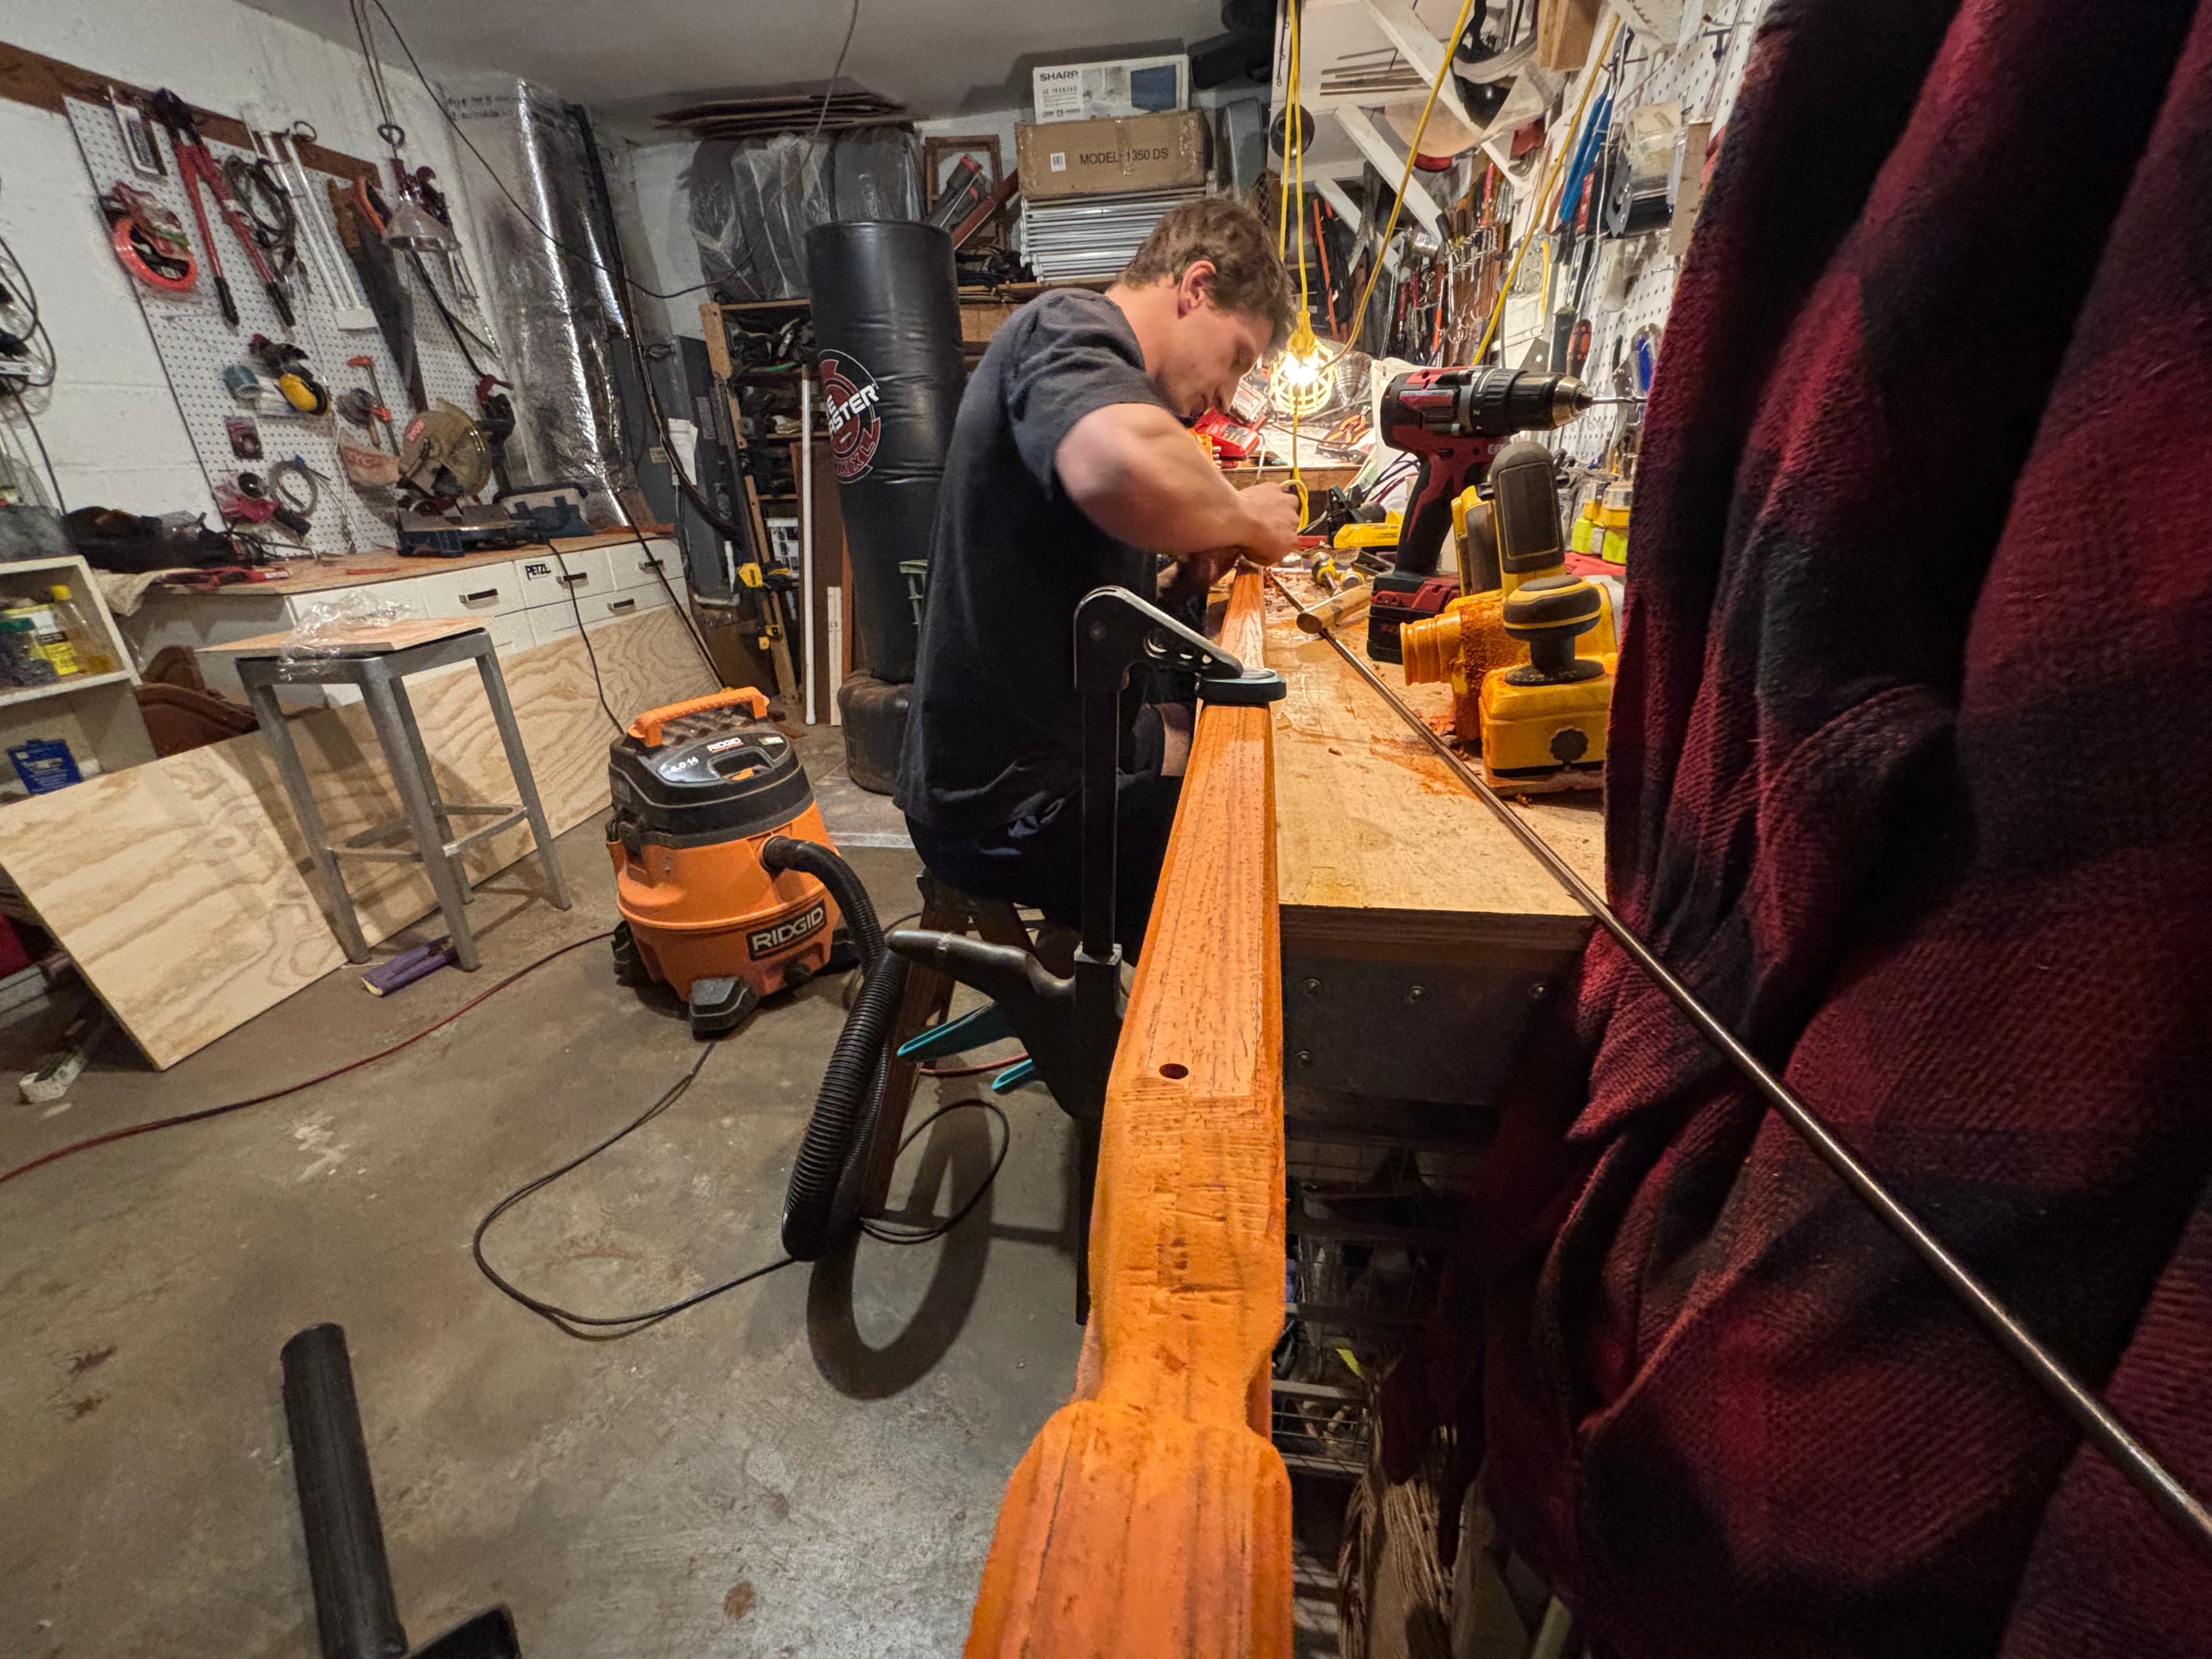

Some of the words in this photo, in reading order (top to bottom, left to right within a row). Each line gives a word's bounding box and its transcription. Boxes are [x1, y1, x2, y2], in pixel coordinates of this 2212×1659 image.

[1040, 70, 1079, 81] SHARP
[1127, 149, 1150, 162] 1350
[1153, 147, 1168, 160] DS
[828, 384, 880, 434] ASTER
[838, 442, 876, 475] XXL
[525, 563, 551, 581] PETZL
[707, 737, 741, 751] RIDGID
[752, 907, 824, 951] RIDGID
